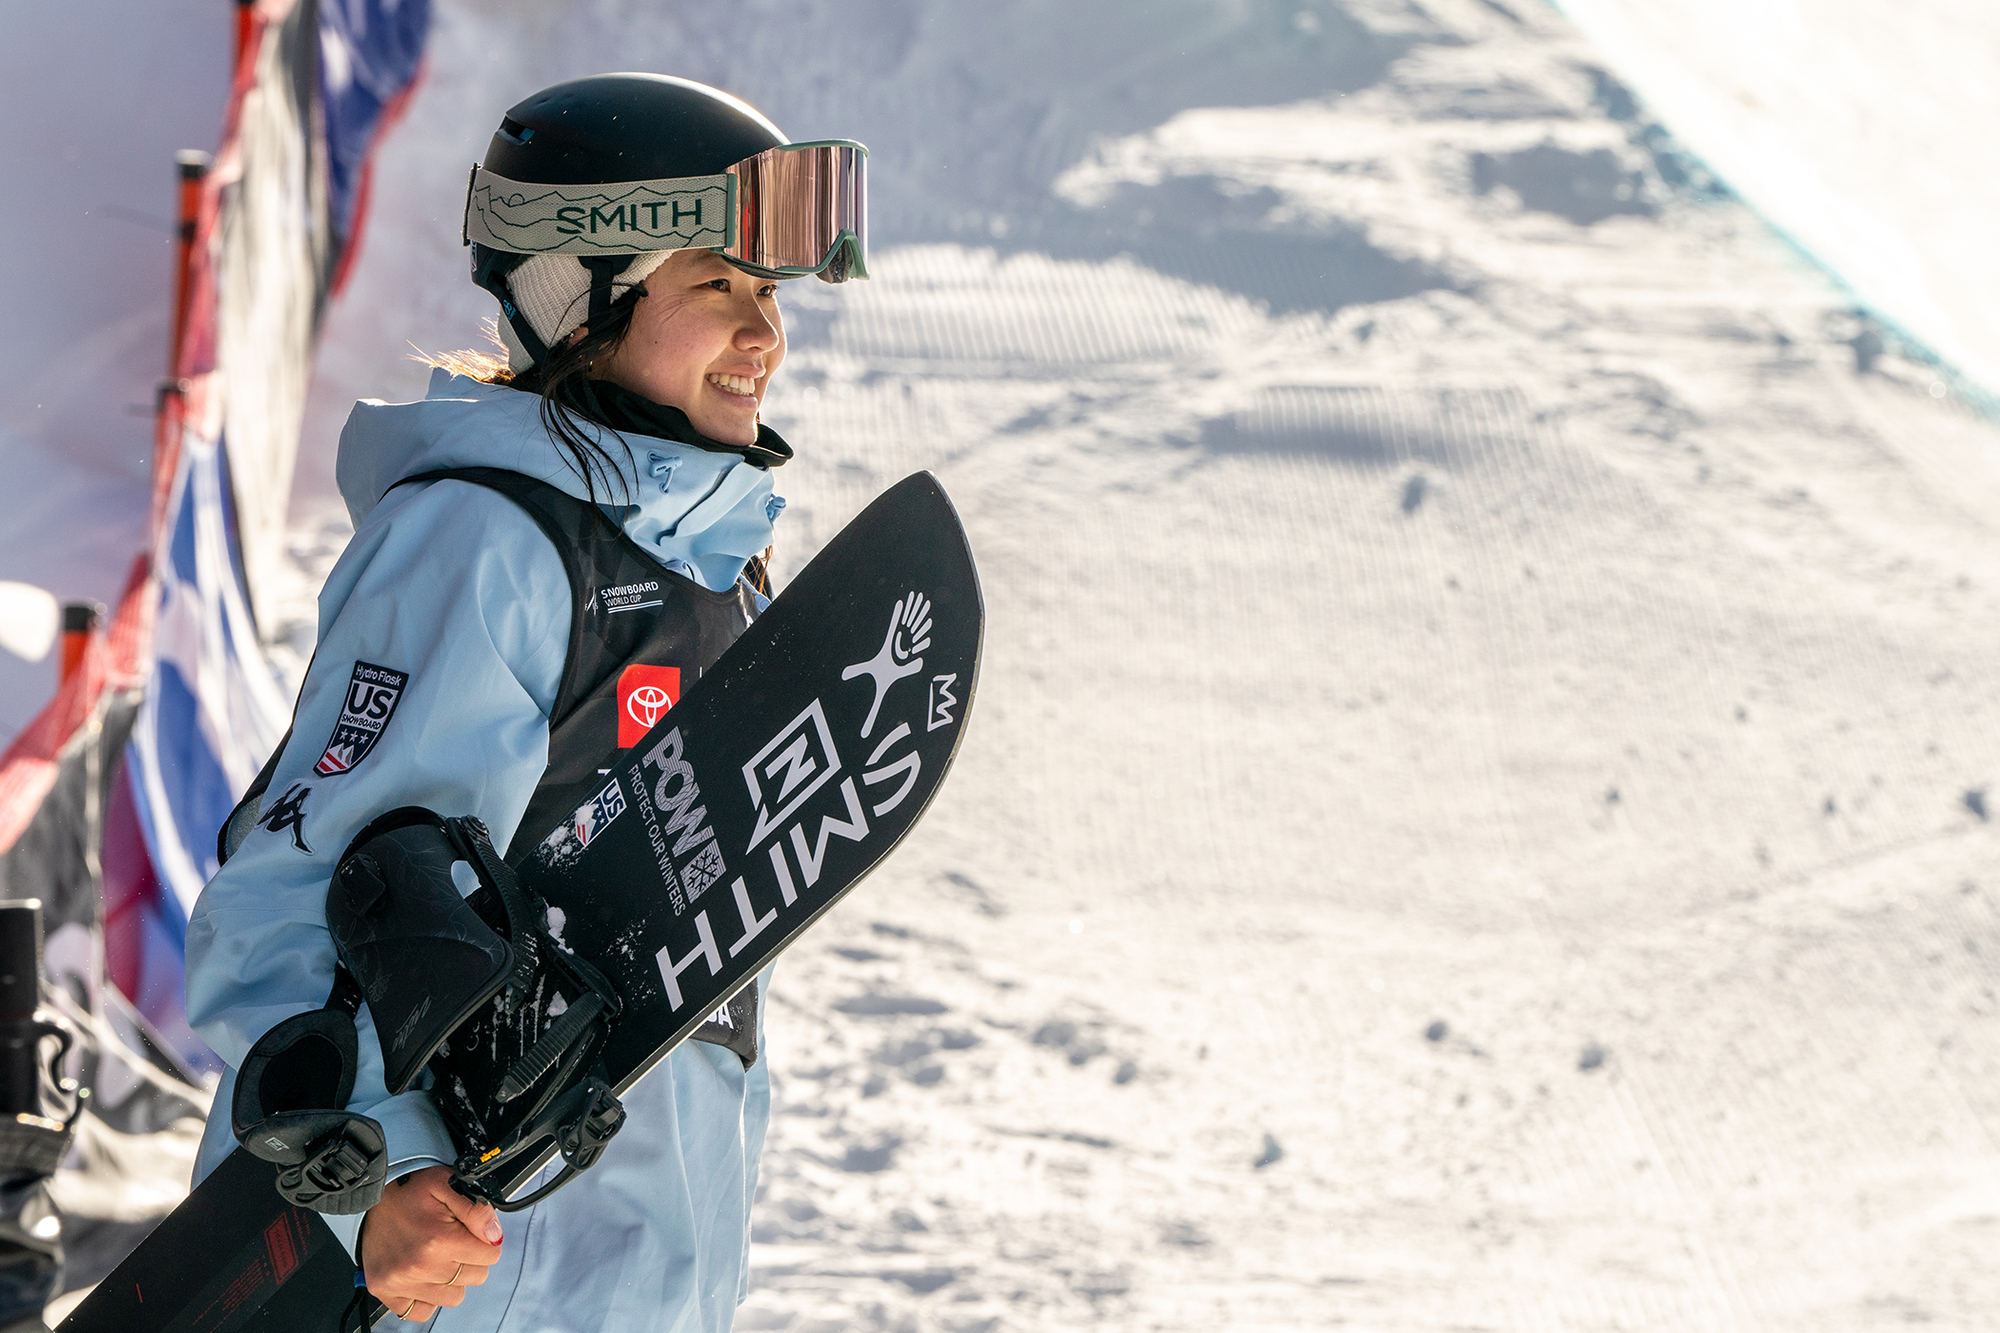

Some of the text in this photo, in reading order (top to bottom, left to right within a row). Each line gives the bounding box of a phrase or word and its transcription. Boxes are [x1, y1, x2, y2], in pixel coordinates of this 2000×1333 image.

[557, 199, 702, 234] SMITH
[601, 581, 658, 599] SNOWBOARD
[604, 594, 642, 607] WORLD CUP
[356, 665, 402, 686] Hydro Flask
[348, 684, 393, 719] US
[341, 714, 382, 729] SNOWBOARD
[602, 782, 624, 818] US
[641, 725, 715, 858] POW
[627, 763, 686, 917] PROTECT OUR WINTERS
[655, 722, 922, 1012] SMITH
